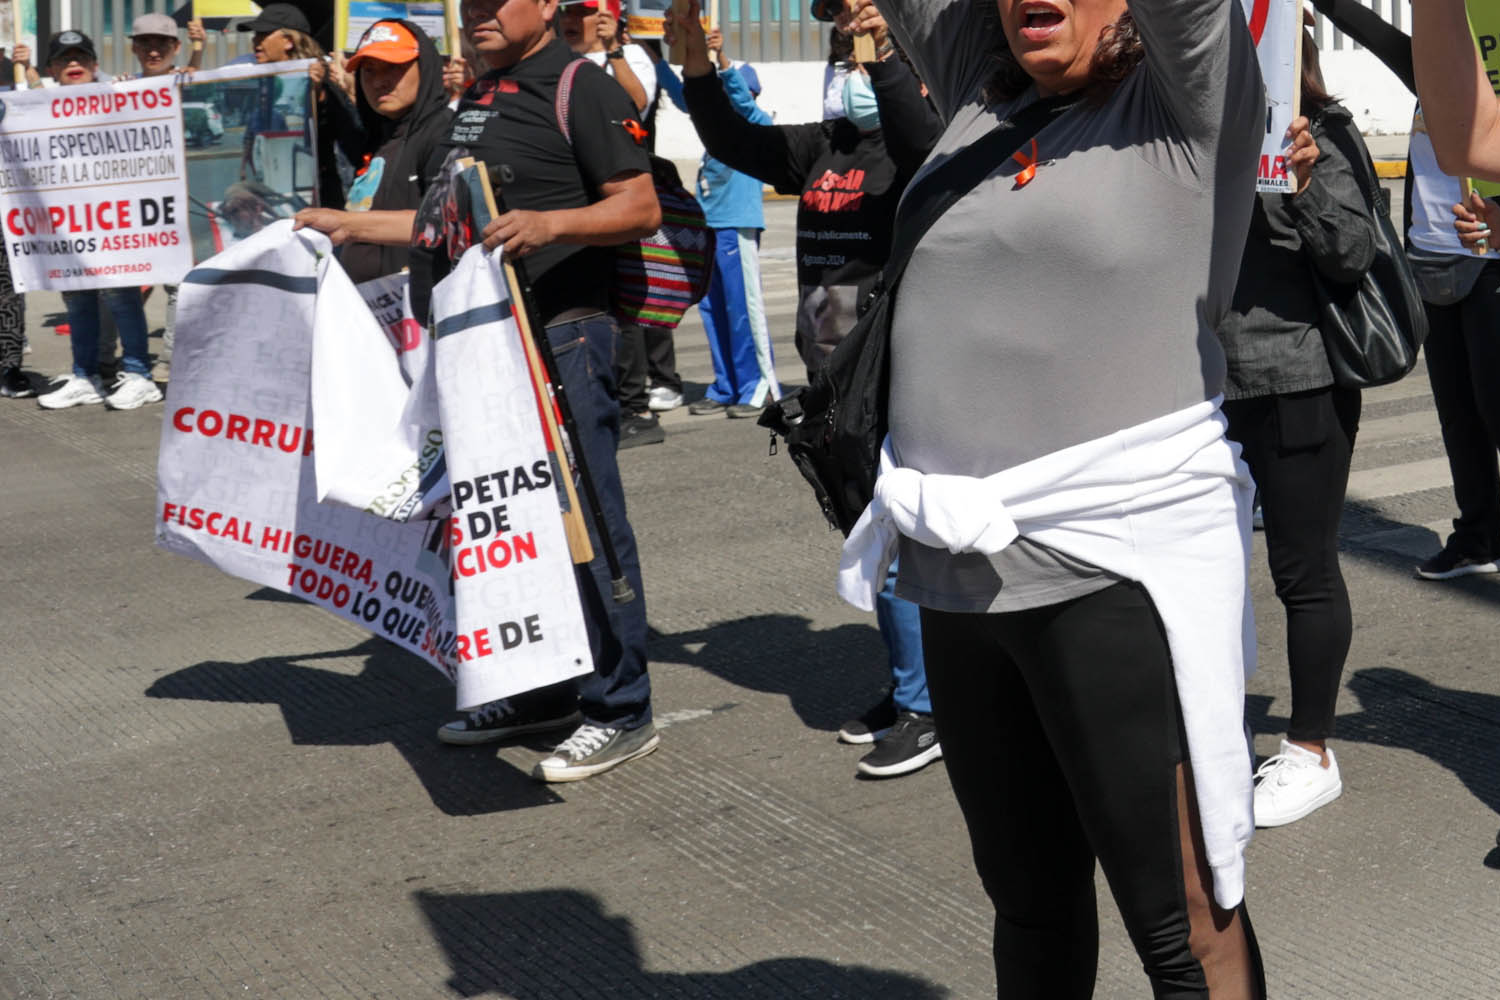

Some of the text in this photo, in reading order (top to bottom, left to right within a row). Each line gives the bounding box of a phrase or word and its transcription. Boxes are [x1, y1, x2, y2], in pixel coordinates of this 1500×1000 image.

[52, 87, 173, 118] CORRUPTOS
[49, 124, 174, 160] ESPECIALIZADA
[60, 163, 69, 184] A
[73, 162, 89, 183] LA
[93, 152, 176, 182] CORRUPCIÓN
[139, 195, 176, 227] DE
[12, 230, 180, 257] FUNARIOS ASESINOS
[467, 504, 512, 541] DE
[162, 501, 254, 546] FISCAL
[260, 526, 380, 594] HIGUERA,
[286, 562, 352, 609] TODO
[350, 591, 381, 623] LO
[382, 606, 426, 646] QUE
[497, 613, 544, 651] DE
